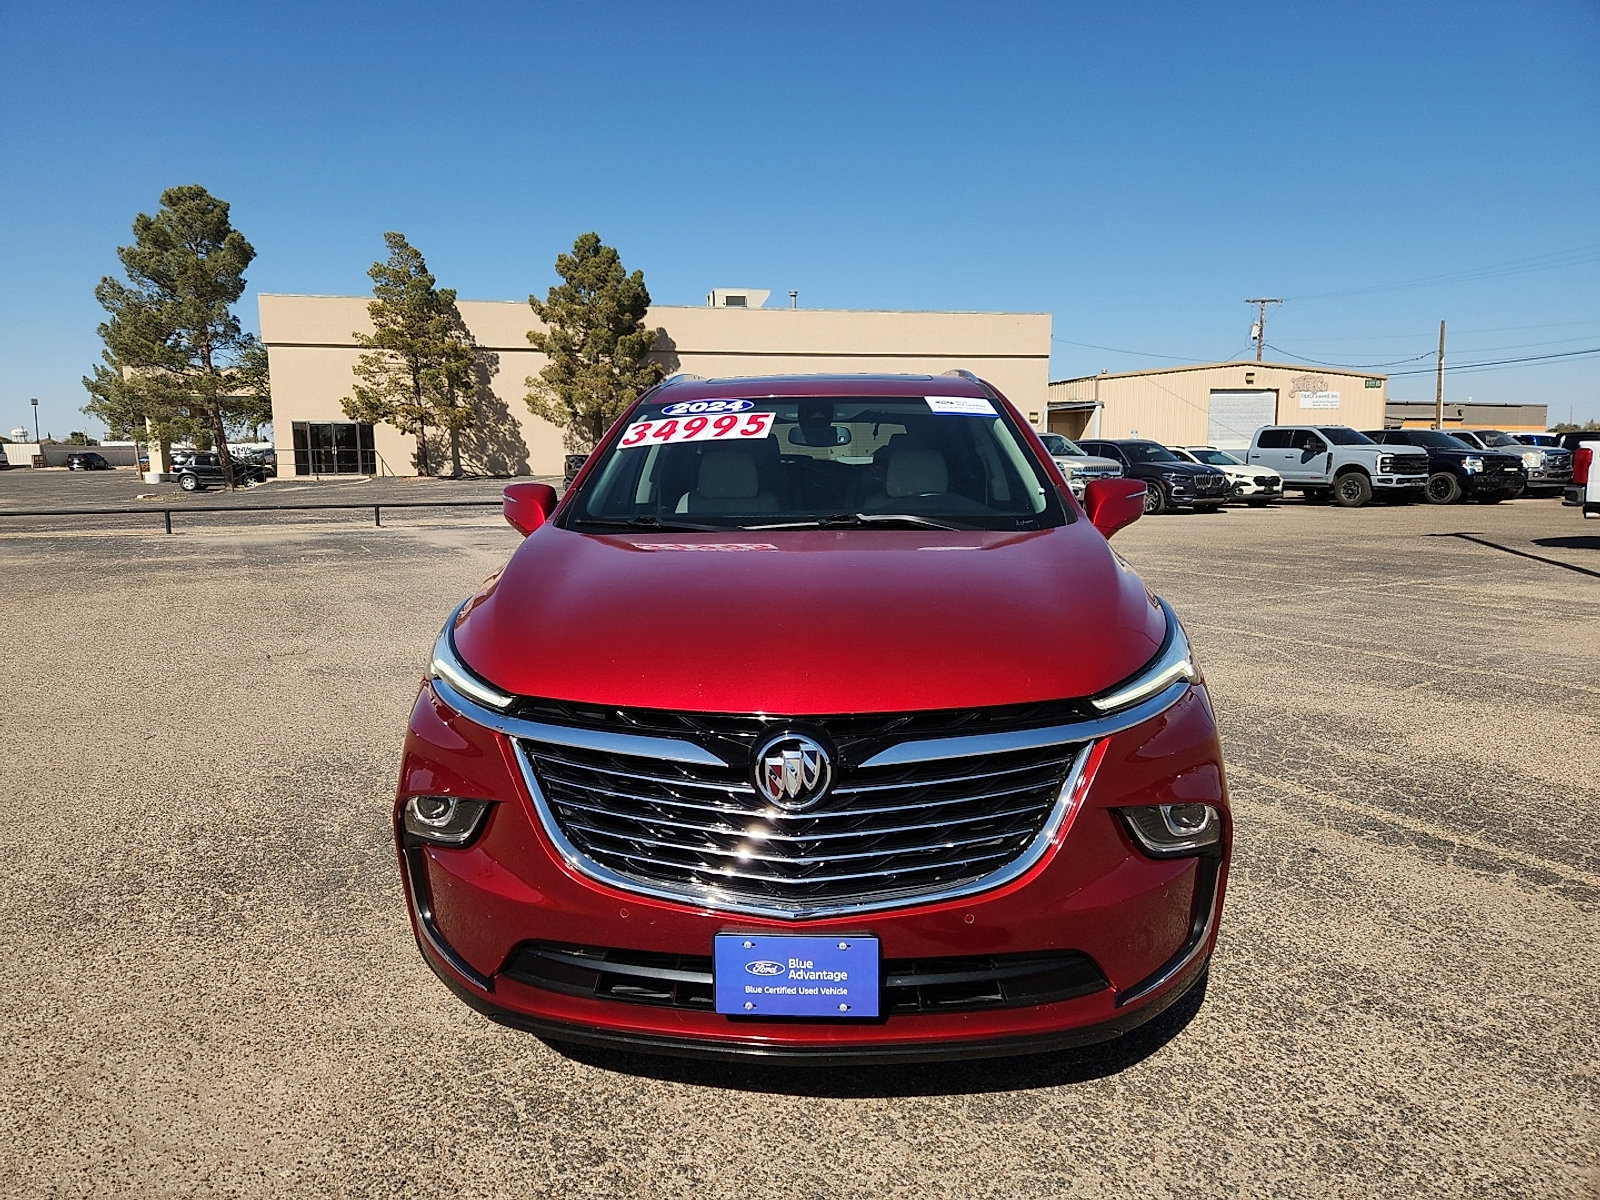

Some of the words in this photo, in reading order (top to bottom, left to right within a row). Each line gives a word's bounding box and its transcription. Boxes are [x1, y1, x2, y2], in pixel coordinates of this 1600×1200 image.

[670, 400, 744, 415] 2024
[622, 414, 771, 446] 34995
[753, 963, 777, 975] Ford
[788, 958, 814, 969] Blue
[788, 970, 848, 982] Advantage
[745, 985, 763, 994] Blue
[764, 986, 797, 995] Certified
[798, 986, 819, 995] Used
[820, 986, 848, 996] Vehicle
